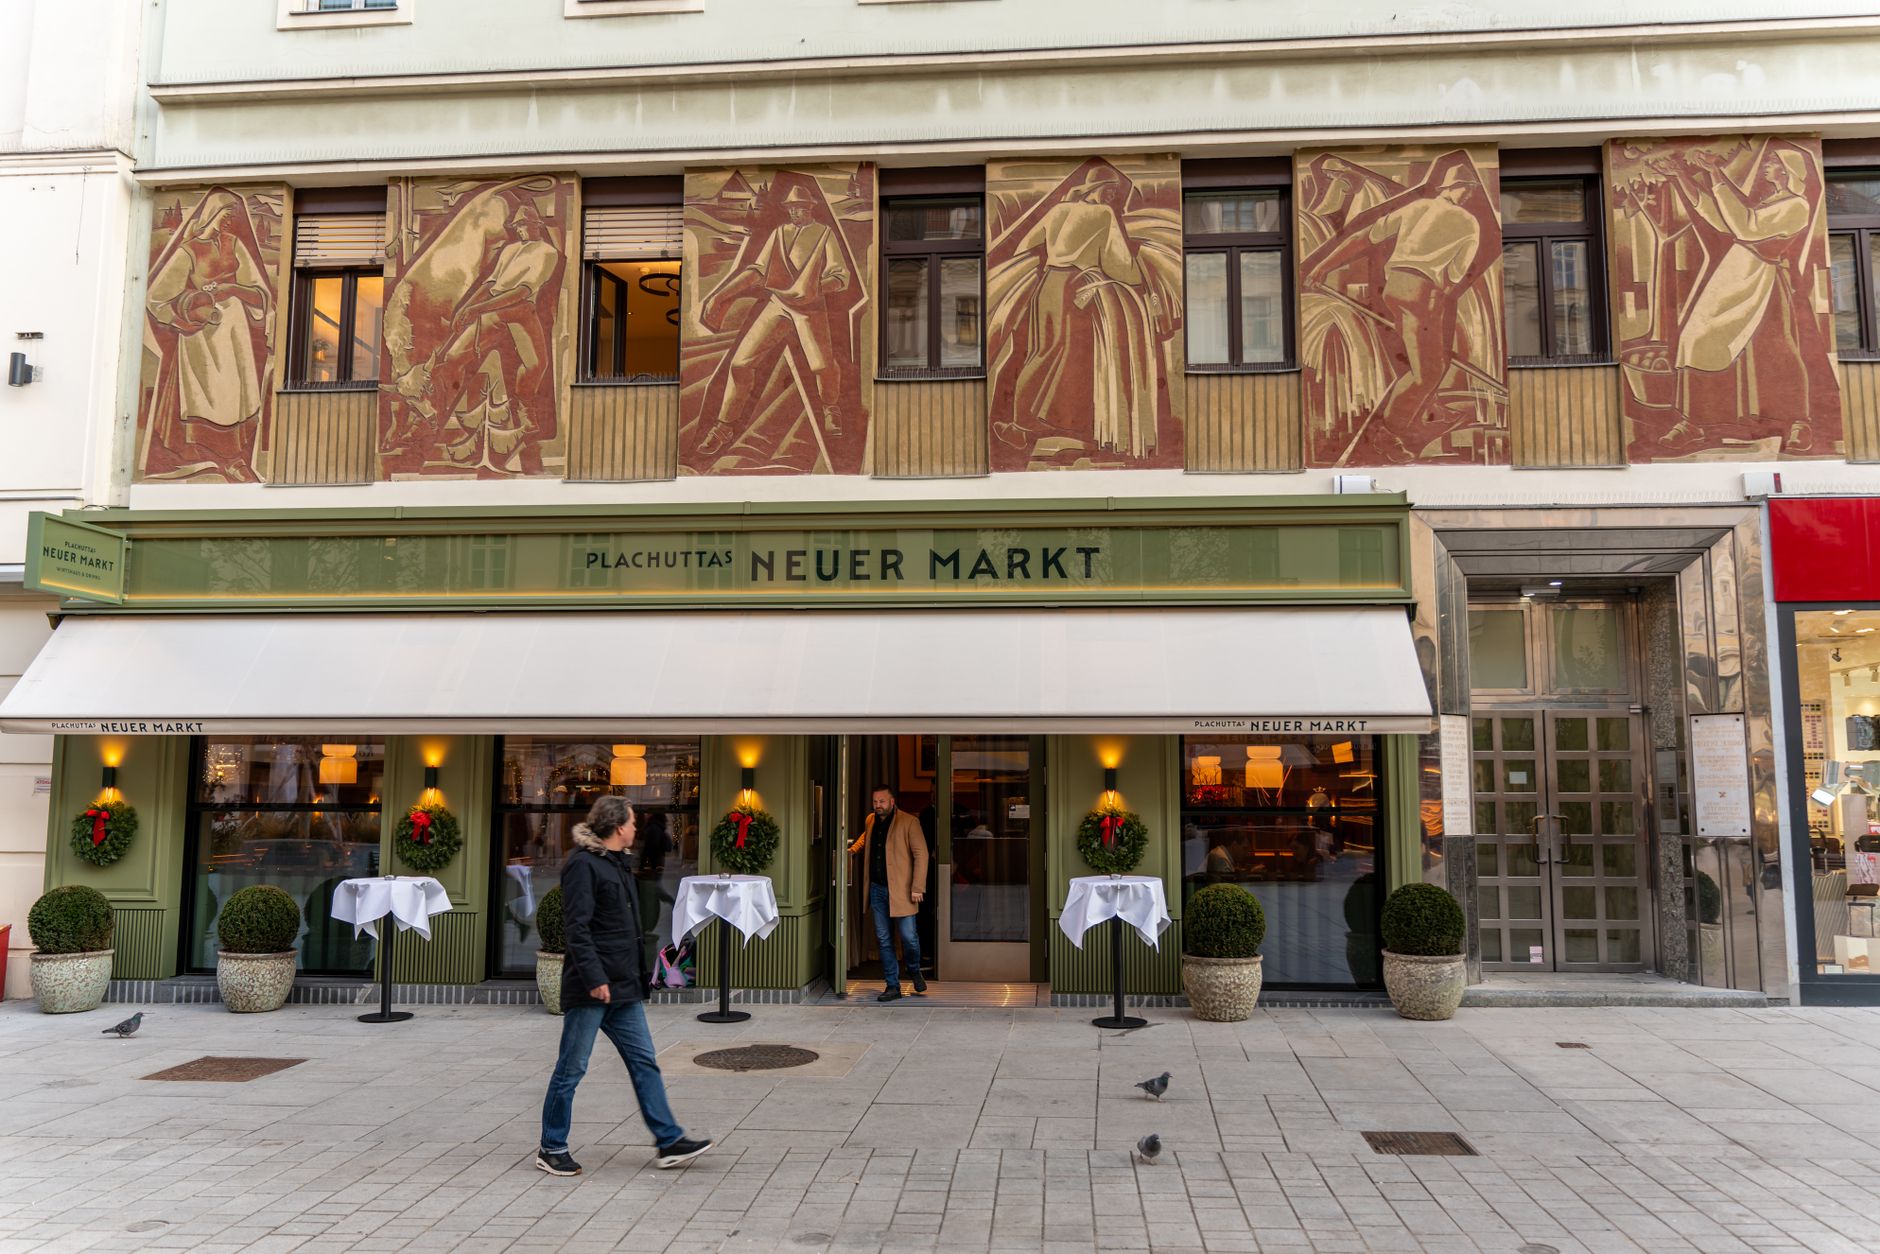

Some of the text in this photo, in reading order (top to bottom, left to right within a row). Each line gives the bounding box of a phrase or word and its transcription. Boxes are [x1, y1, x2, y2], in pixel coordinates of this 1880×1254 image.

[42, 546, 115, 572] NEUER MARKT
[586, 547, 1100, 582] PLACHUTTAS NEUER MARKT
[101, 722, 148, 733] NEUER
[153, 722, 204, 733] MARKT
[1250, 721, 1303, 732] NEUER
[1310, 720, 1368, 732] MARKT
